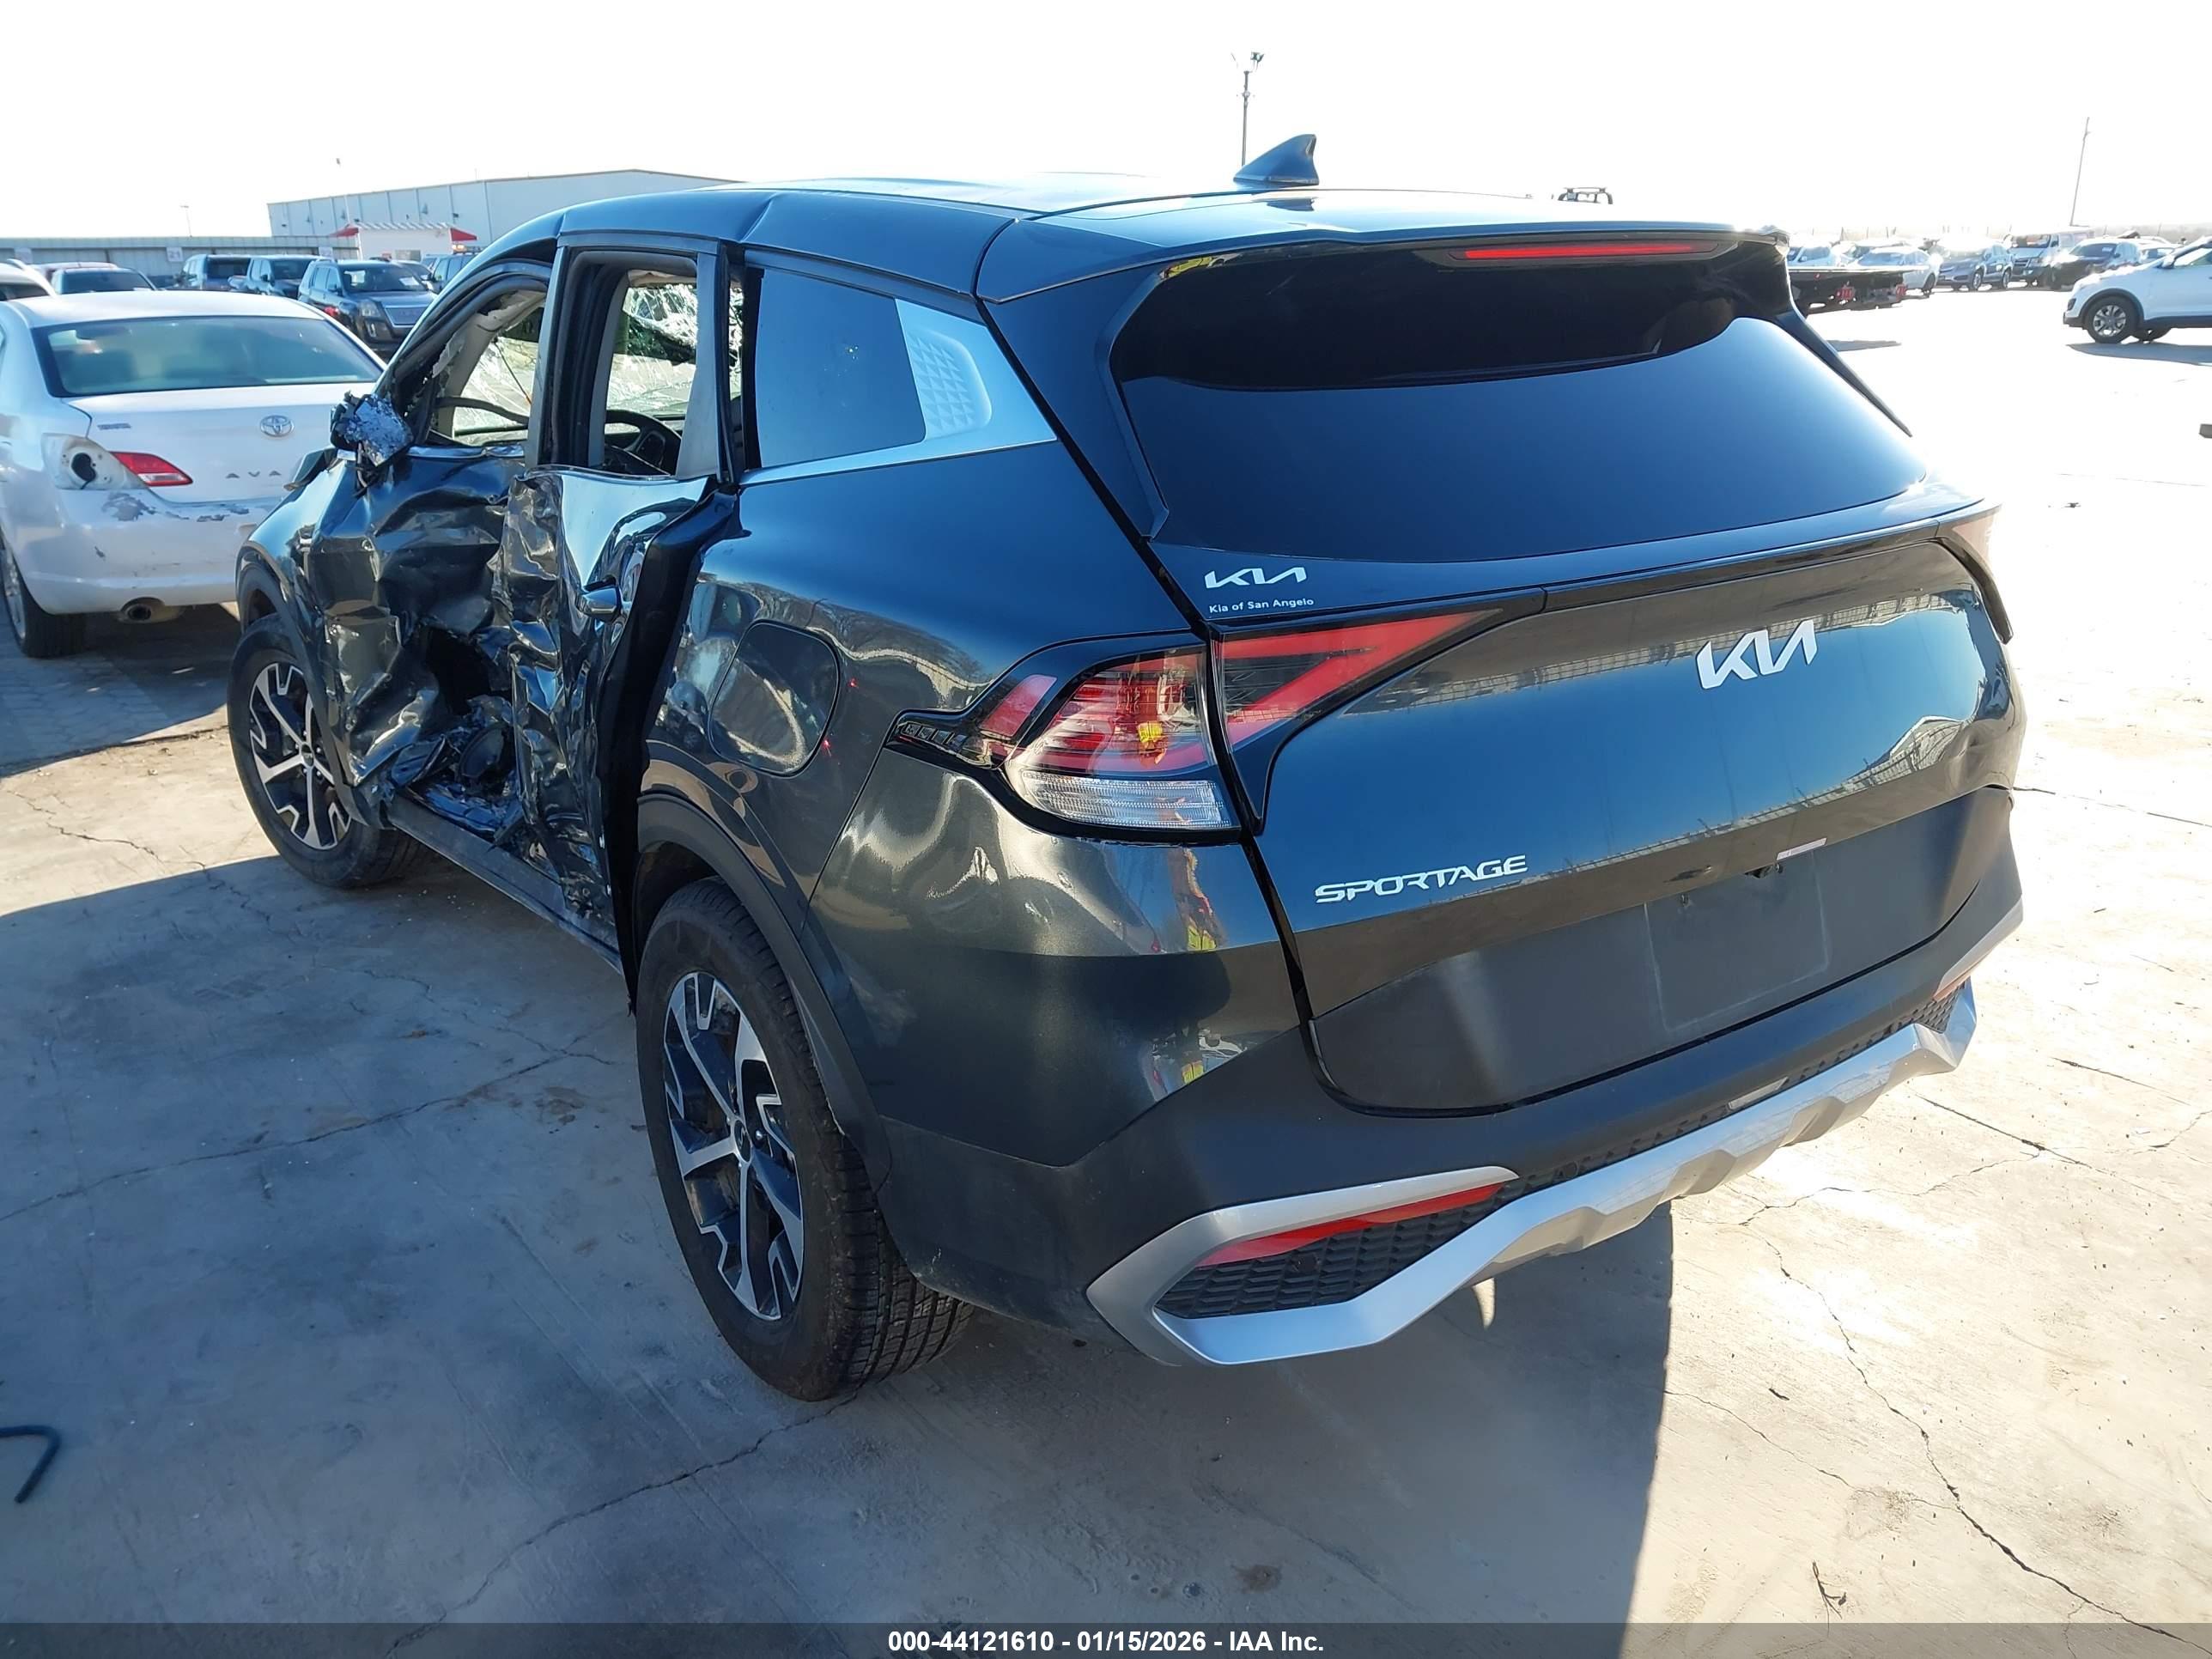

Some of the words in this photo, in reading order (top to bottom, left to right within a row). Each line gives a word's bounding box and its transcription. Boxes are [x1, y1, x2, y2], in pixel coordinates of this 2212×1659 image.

[1204, 567, 1307, 589] KIA
[1209, 604, 1229, 613] Kia
[1232, 601, 1244, 611] of
[1248, 599, 1269, 610] San
[1273, 598, 1315, 609] Angelo
[1696, 619, 1818, 690] KIA
[1315, 854, 1529, 903] SPORTAGE
